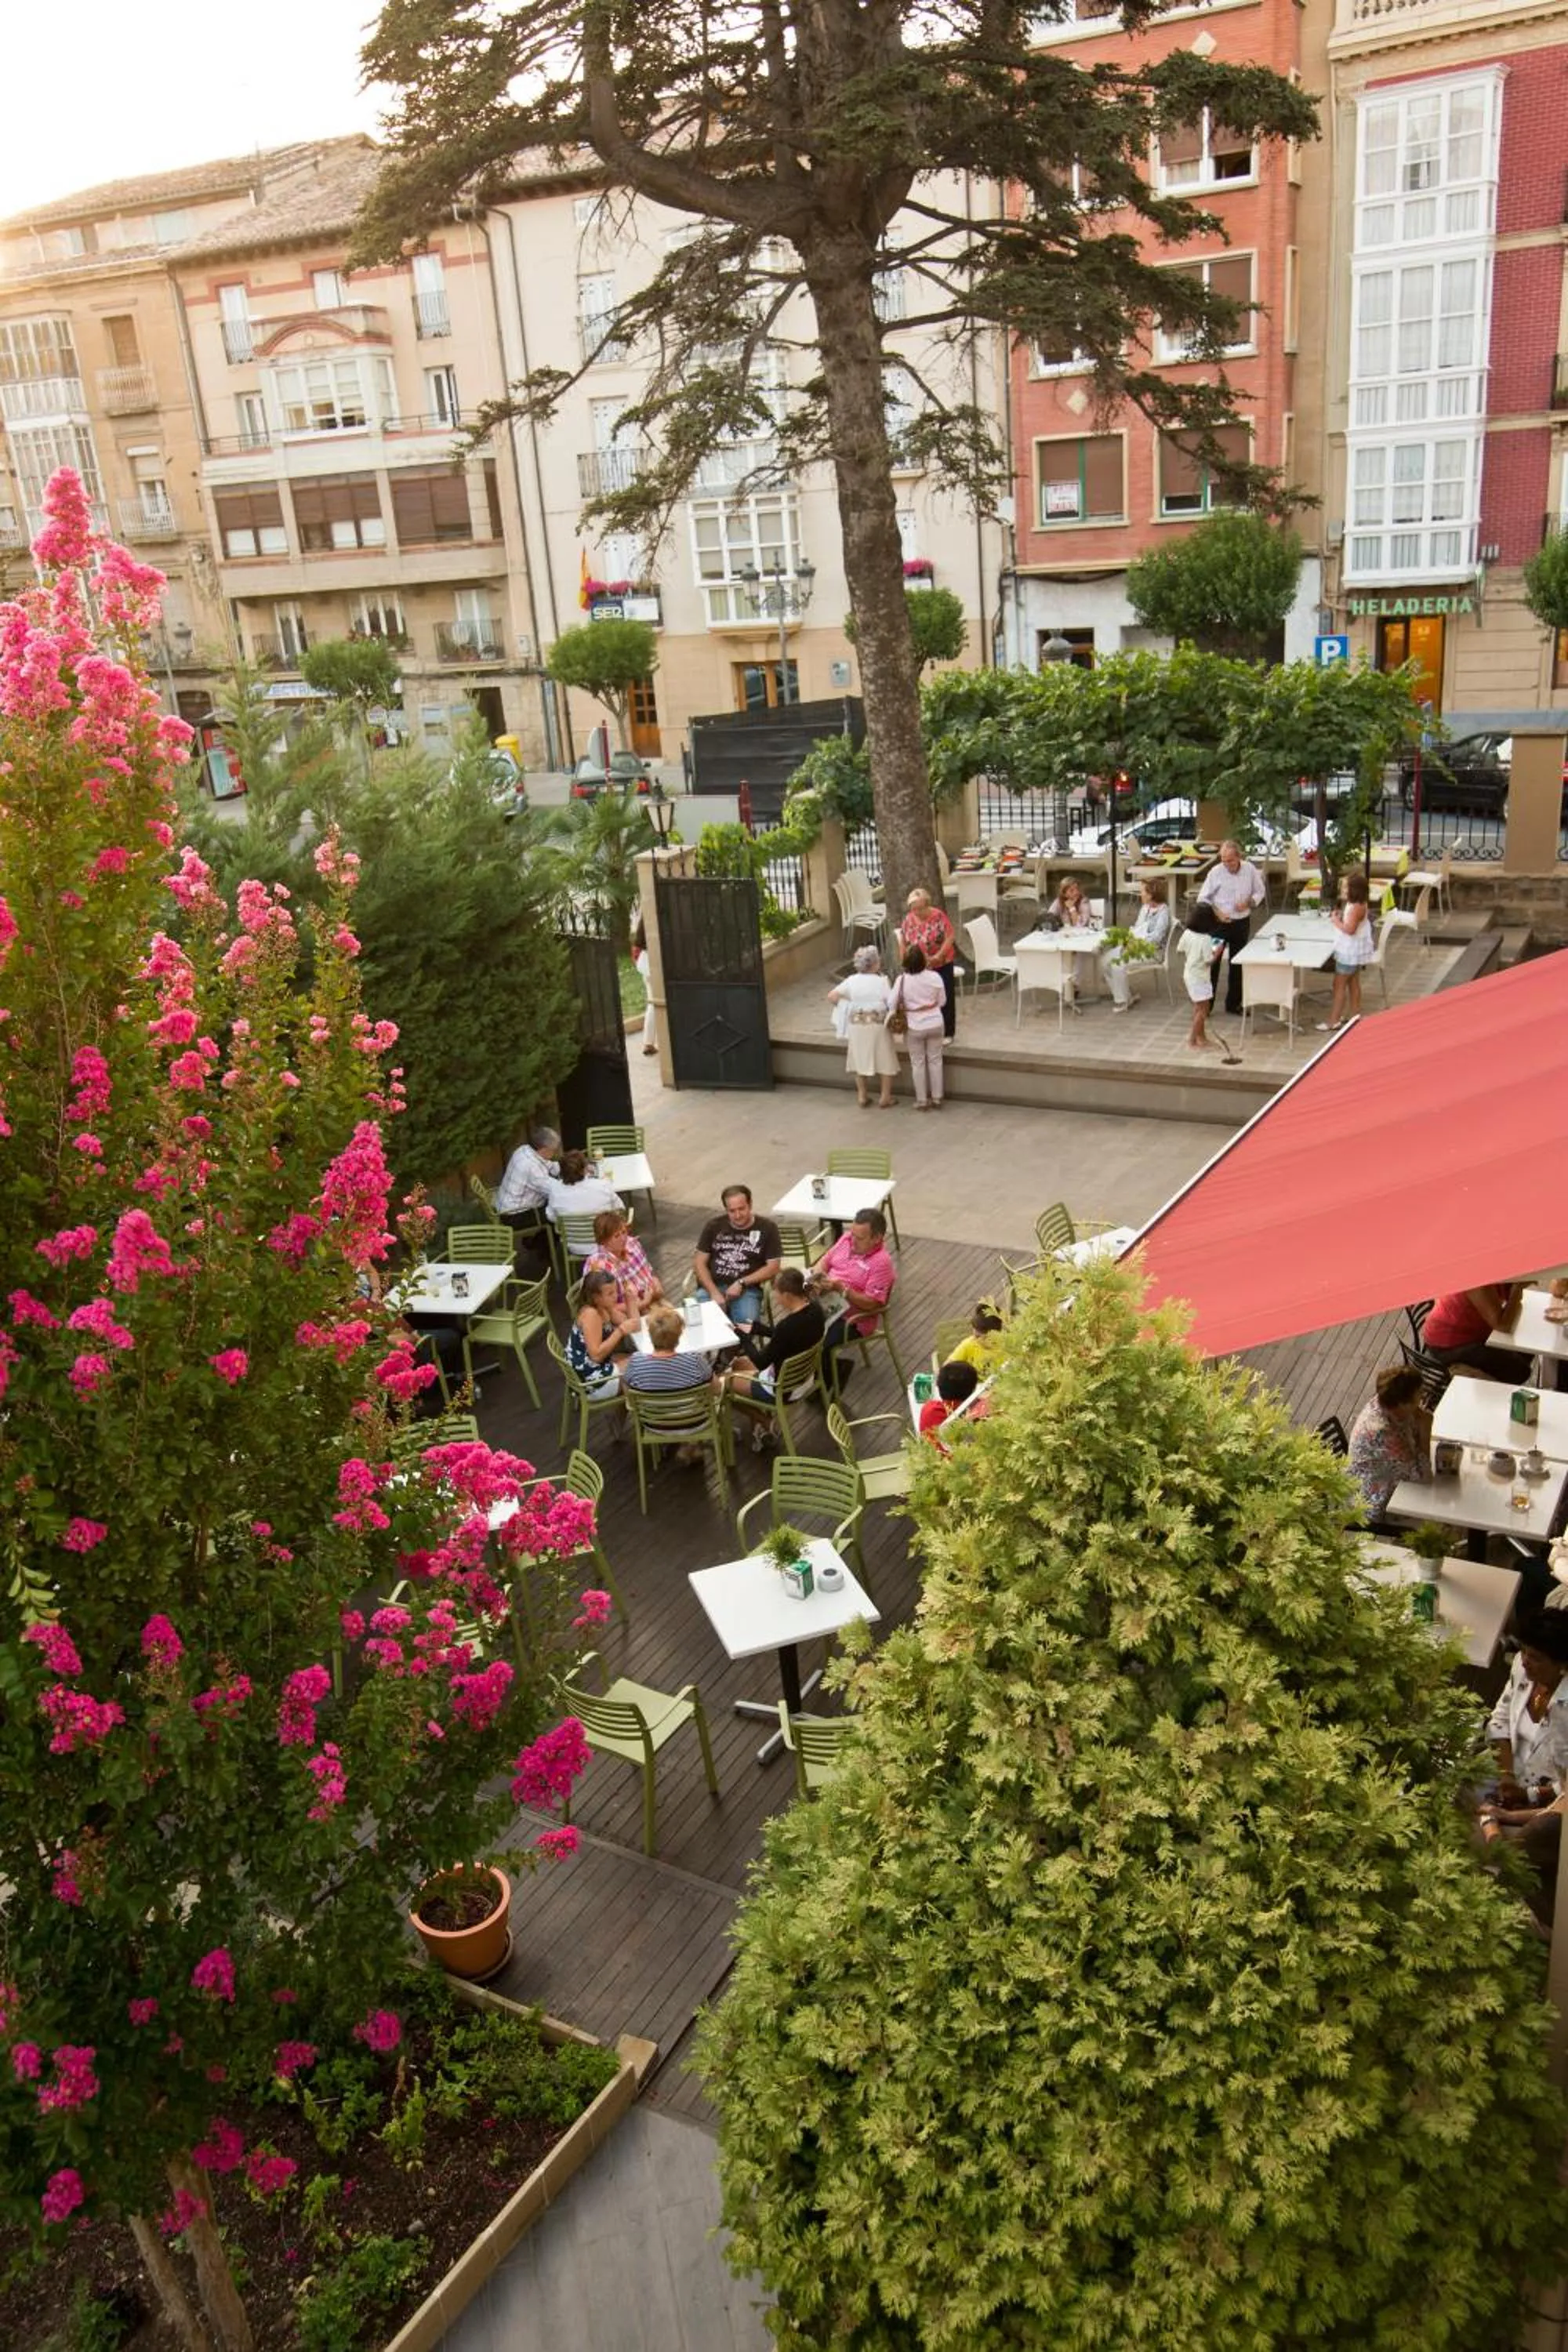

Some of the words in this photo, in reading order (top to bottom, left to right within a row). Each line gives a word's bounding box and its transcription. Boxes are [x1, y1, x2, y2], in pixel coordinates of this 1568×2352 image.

[593, 605, 623, 619] SER
[1351, 595, 1473, 615] HELADERIA
[1321, 639, 1341, 666] P
